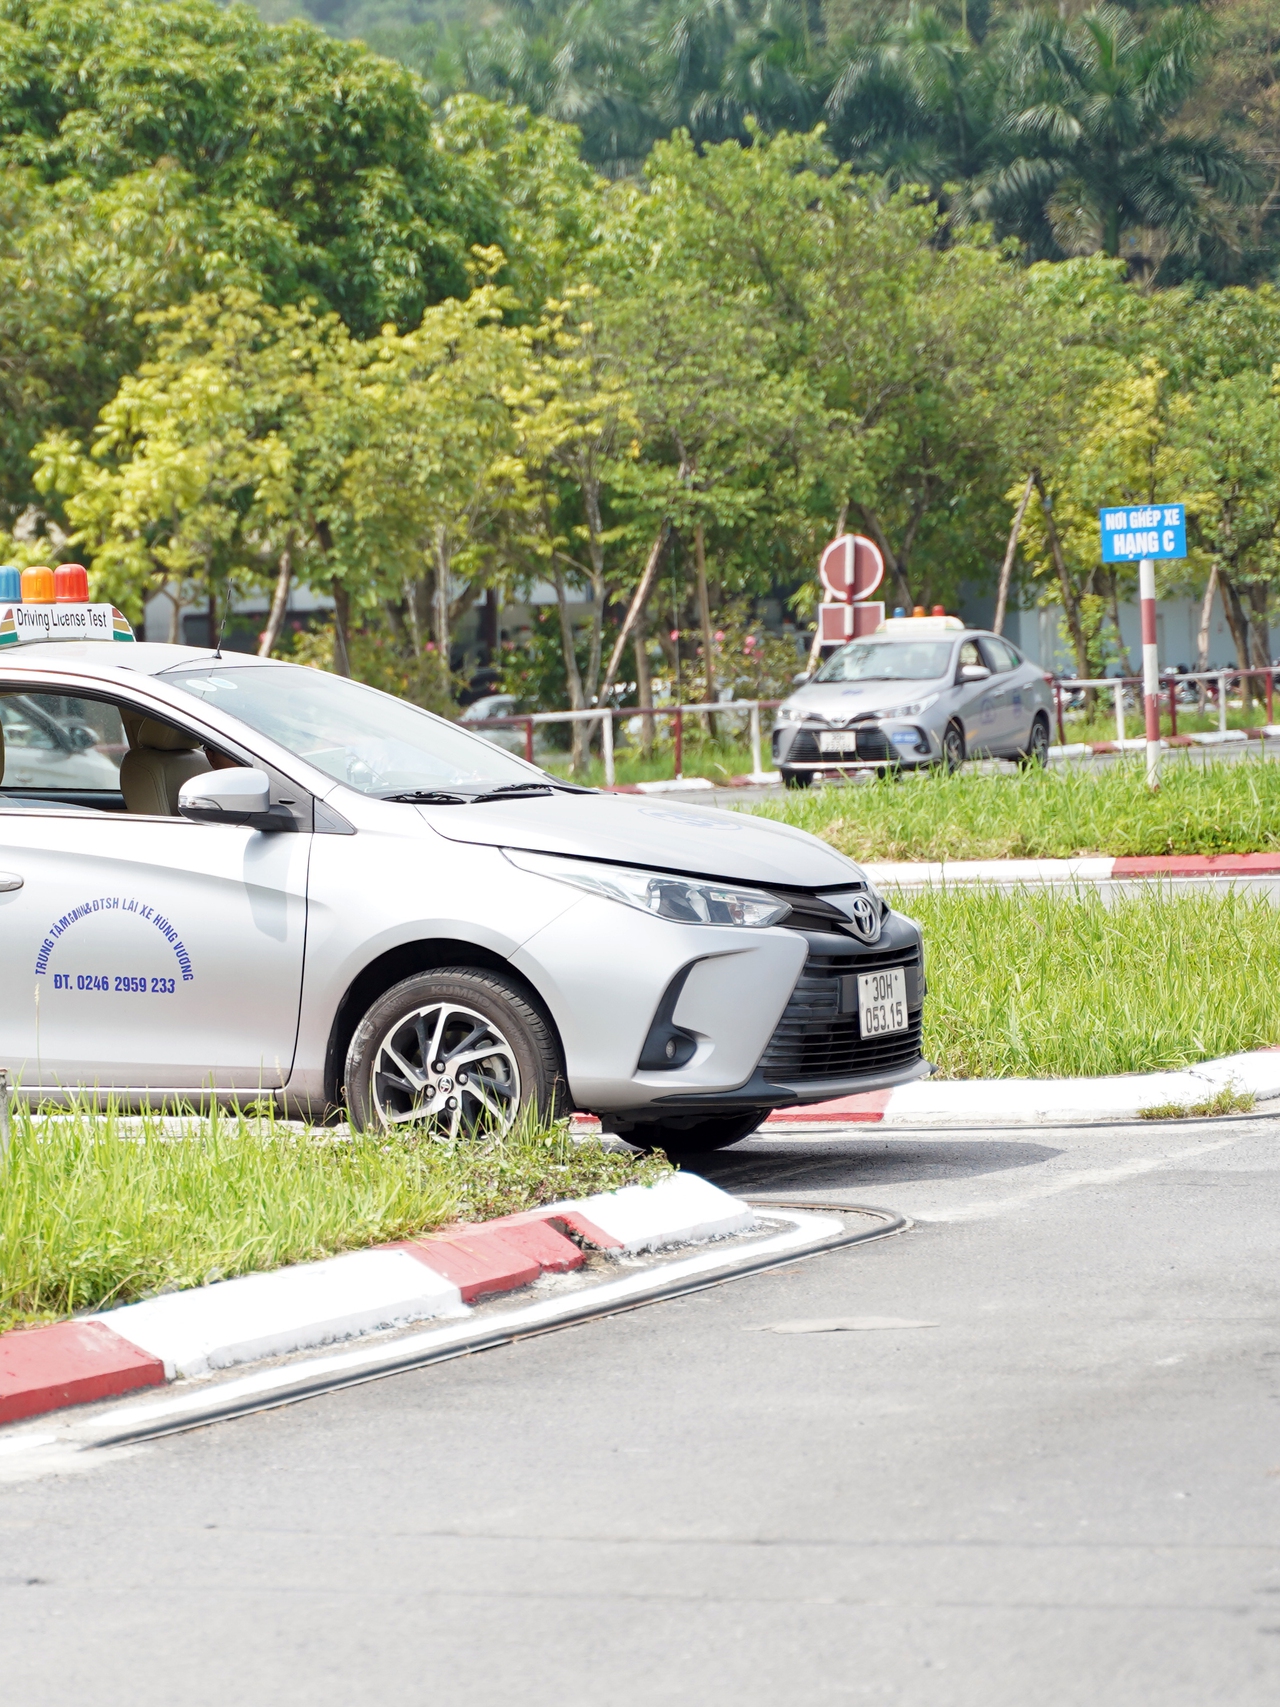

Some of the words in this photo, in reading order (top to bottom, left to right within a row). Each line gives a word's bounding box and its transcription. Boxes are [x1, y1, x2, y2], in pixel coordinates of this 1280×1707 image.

[1105, 511, 1127, 531] NƠI
[1129, 507, 1161, 529] GHÉP
[1164, 508, 1180, 527] XE
[1113, 531, 1160, 559] HẠNG
[1162, 530, 1175, 552] C
[16, 608, 49, 631] Driving
[51, 609, 86, 627] License
[87, 609, 107, 628] Test
[35, 938, 55, 975] TRUNG
[139, 904, 154, 920] XE
[54, 973, 73, 990] ĐT.
[77, 975, 109, 991] 0246
[114, 976, 147, 993] 2959
[151, 977, 175, 994] 233
[872, 973, 894, 1002] 30H
[865, 1001, 904, 1034] 053.15
